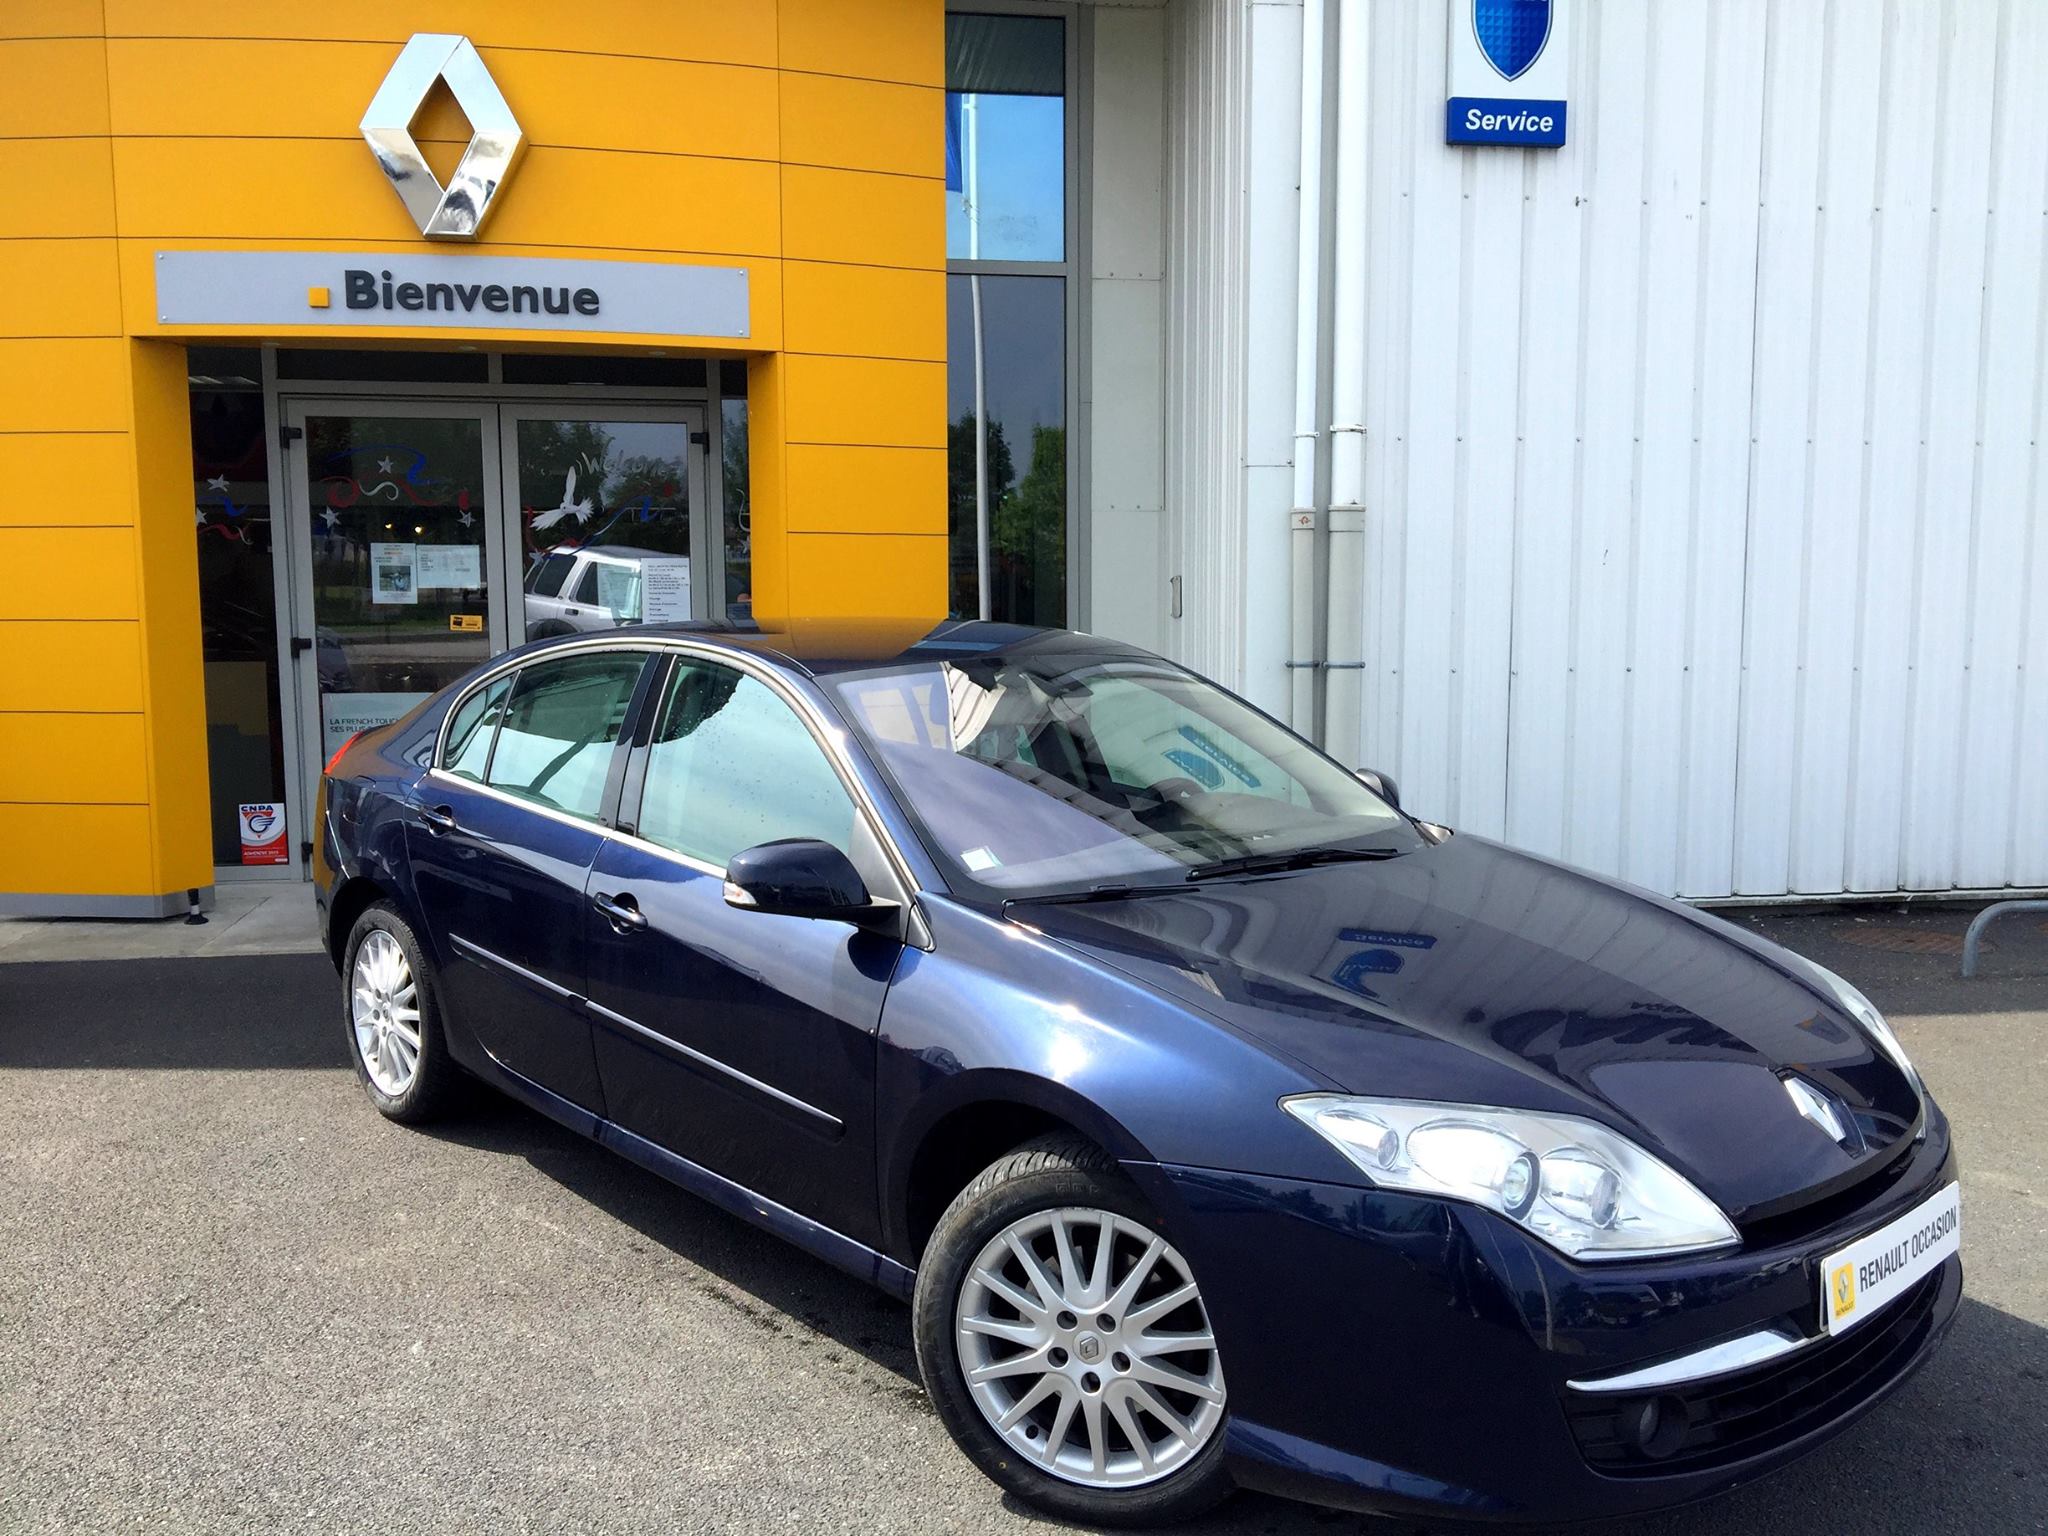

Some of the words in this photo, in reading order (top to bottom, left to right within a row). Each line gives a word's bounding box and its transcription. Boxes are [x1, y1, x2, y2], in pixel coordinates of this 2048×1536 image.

[1465, 108, 1553, 132] Service
[345, 269, 600, 315] Bienvenue
[1859, 1240, 1909, 1292] RENAULT
[1911, 1205, 1957, 1259] OCCASION
